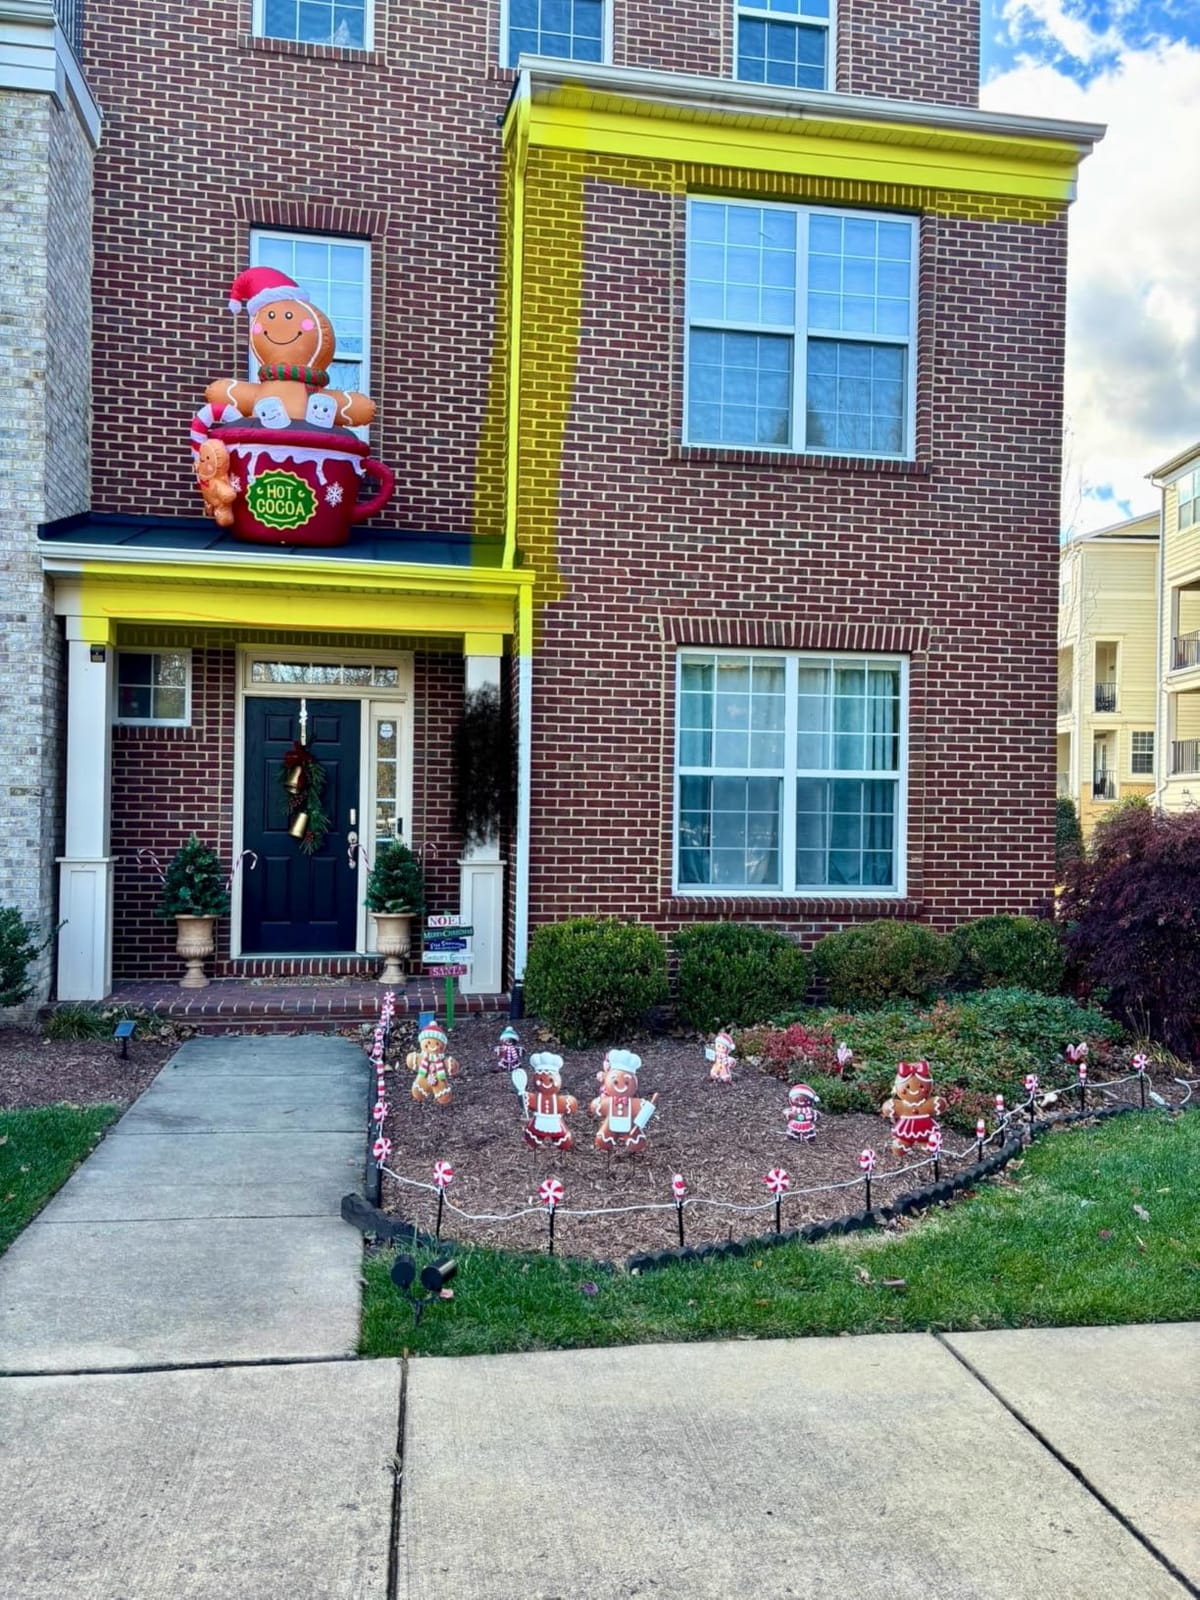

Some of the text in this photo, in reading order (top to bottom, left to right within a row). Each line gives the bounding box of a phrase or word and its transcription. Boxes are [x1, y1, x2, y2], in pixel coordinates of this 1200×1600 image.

[267, 484, 293, 499] HOT
[256, 498, 305, 516] COCOA
[430, 916, 467, 925] NOEL
[432, 966, 462, 976] SANTA
